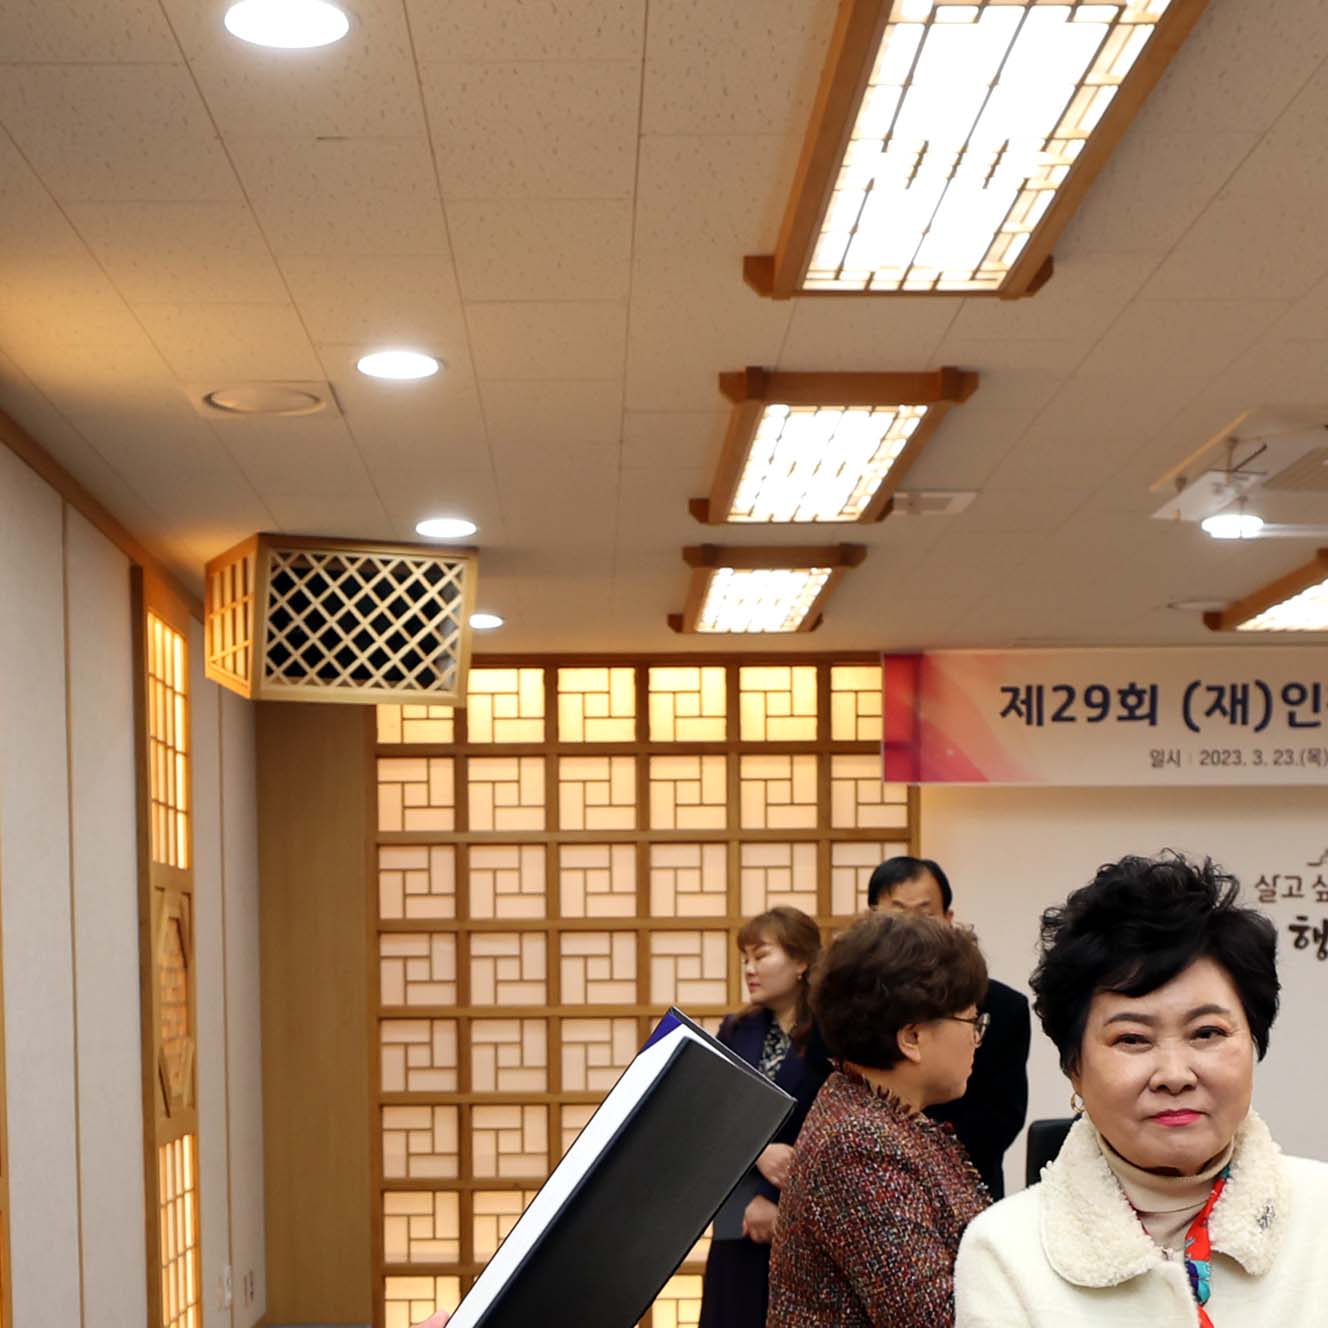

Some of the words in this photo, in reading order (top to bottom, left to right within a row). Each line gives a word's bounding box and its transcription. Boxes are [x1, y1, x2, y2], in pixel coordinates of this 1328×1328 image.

[999, 682, 1159, 727] 제29회
[1149, 749, 1181, 768] 일시
[1254, 874, 1305, 903] 살고
